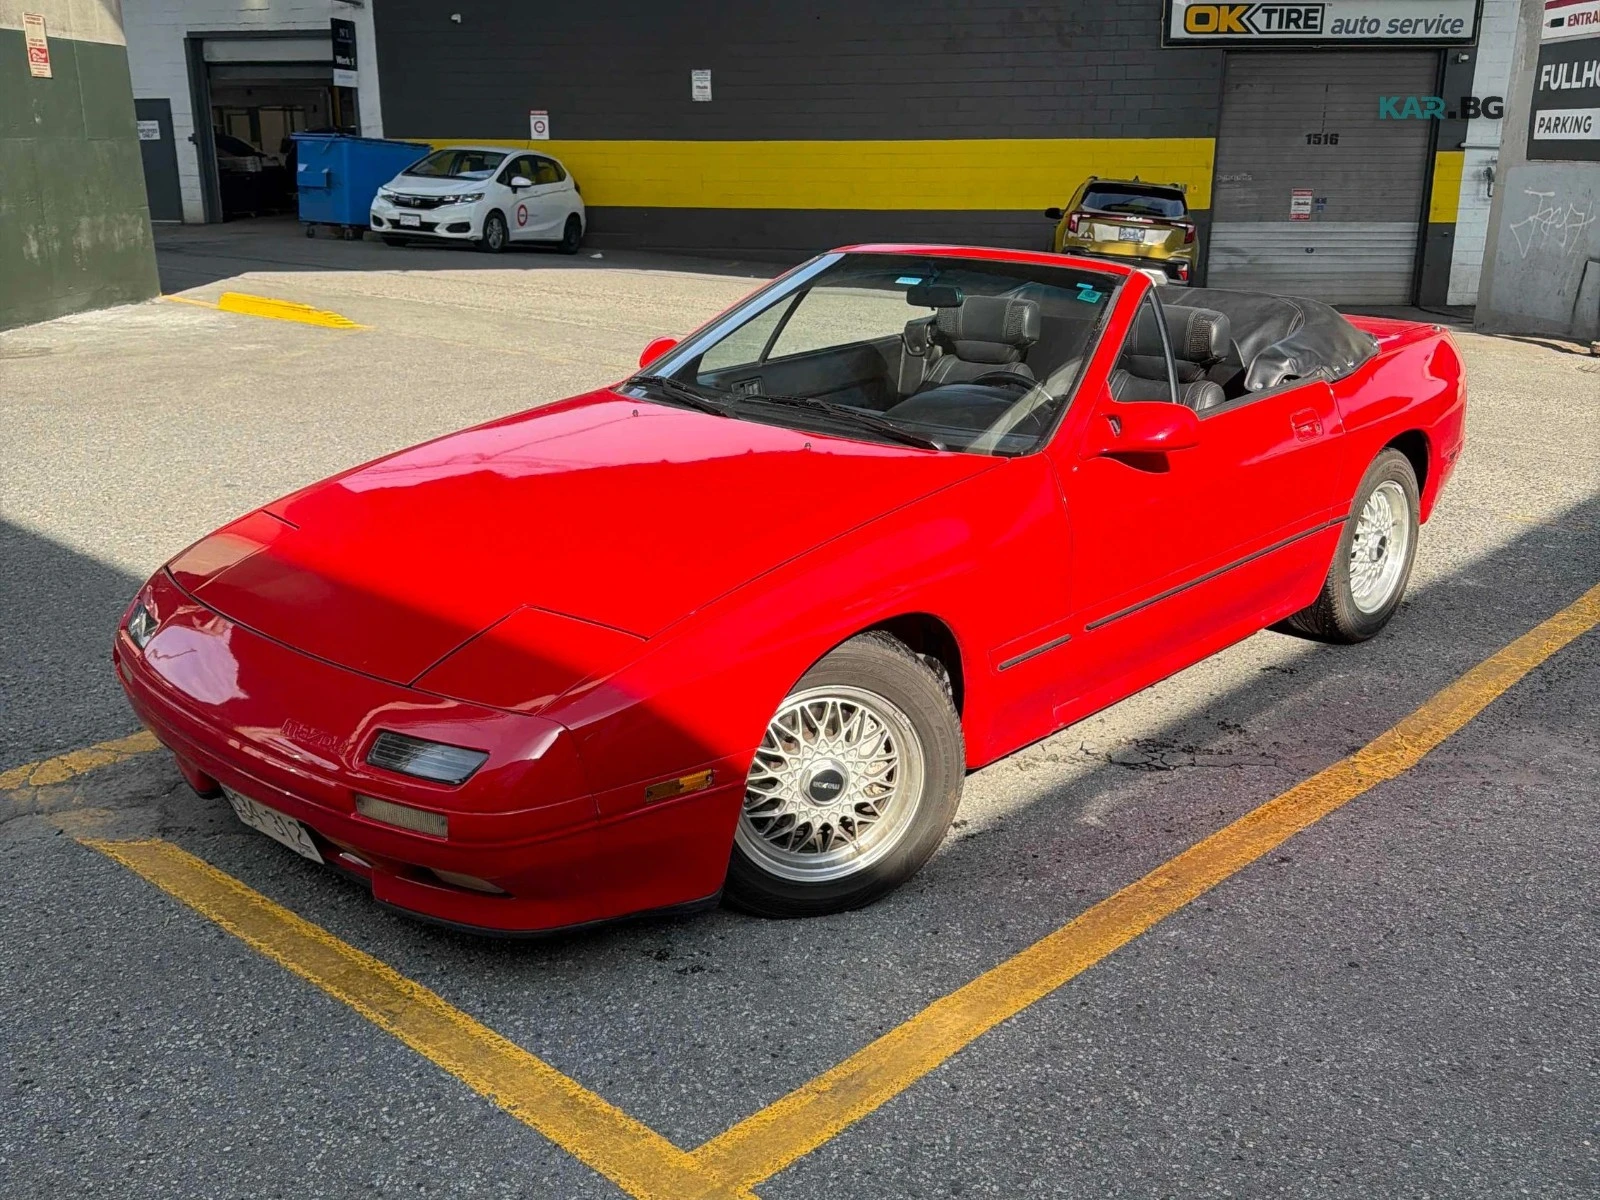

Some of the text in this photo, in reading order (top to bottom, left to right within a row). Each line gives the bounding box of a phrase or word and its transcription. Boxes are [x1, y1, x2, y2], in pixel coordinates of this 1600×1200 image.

[1185, 5, 1250, 33] OK
[1261, 8, 1320, 30] TIRE
[1331, 14, 1464, 35] auto service
[1568, 10, 1600, 27] ENTRA
[1537, 115, 1592, 133] PARKING
[1305, 133, 1340, 145] 1516
